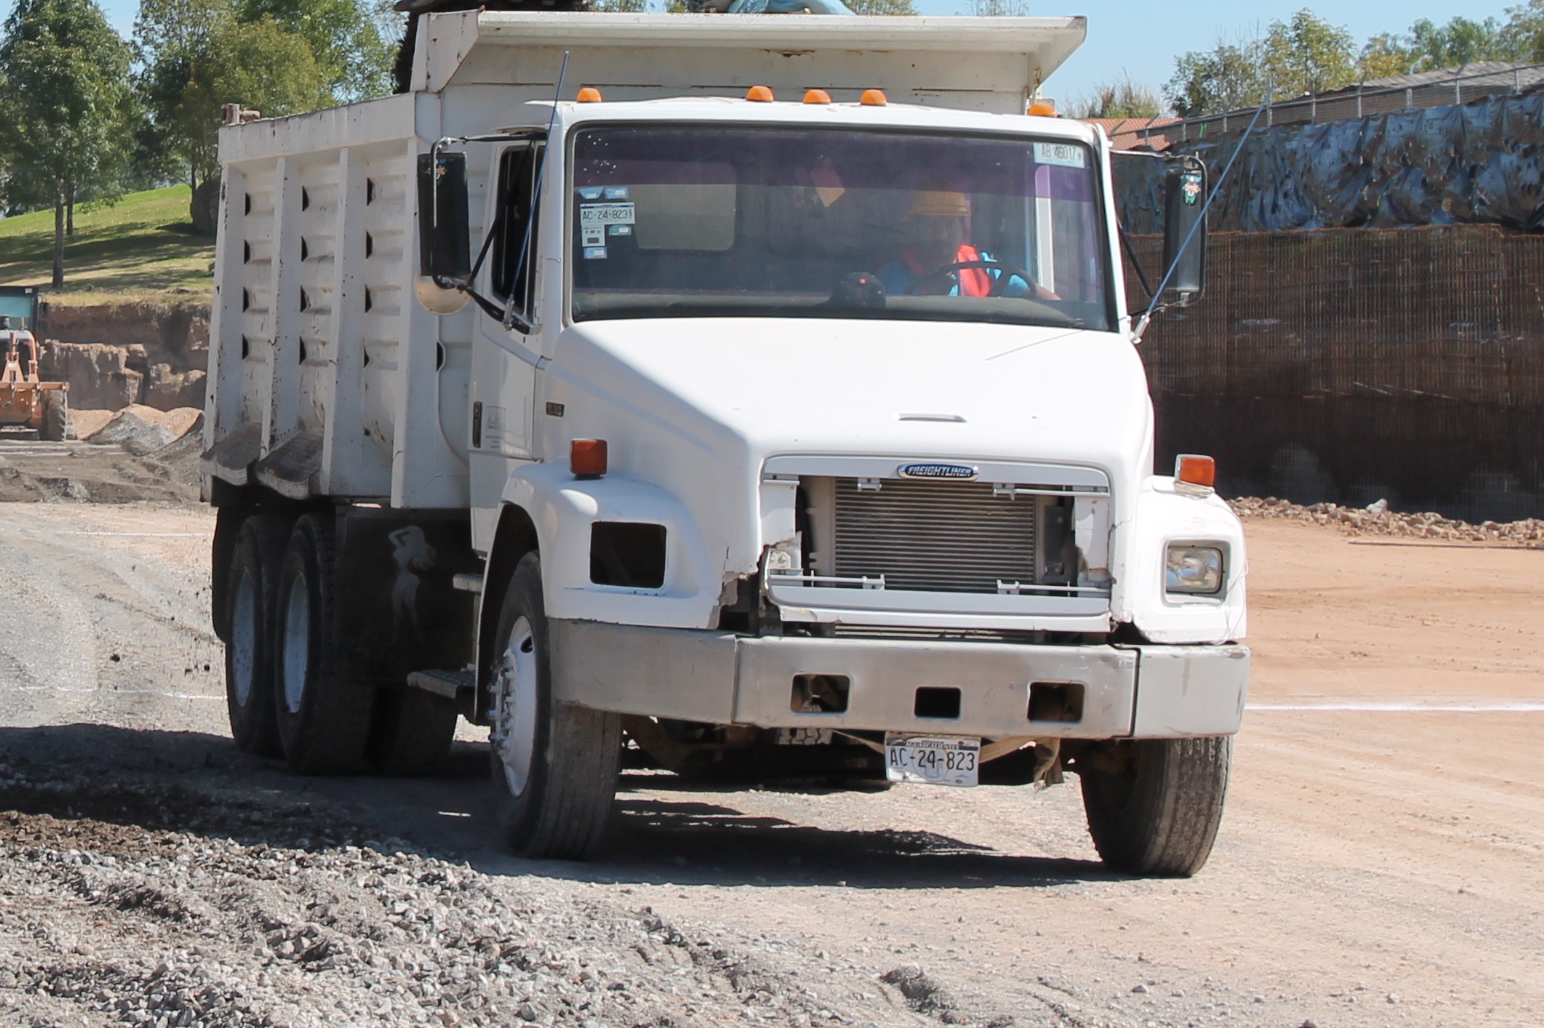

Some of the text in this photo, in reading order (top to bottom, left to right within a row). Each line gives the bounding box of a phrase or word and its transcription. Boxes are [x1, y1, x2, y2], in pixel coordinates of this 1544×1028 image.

[582, 209, 628, 221] AC-24-823
[908, 465, 972, 477] FREIGHTLINER
[890, 747, 975, 771] AC-24-823
